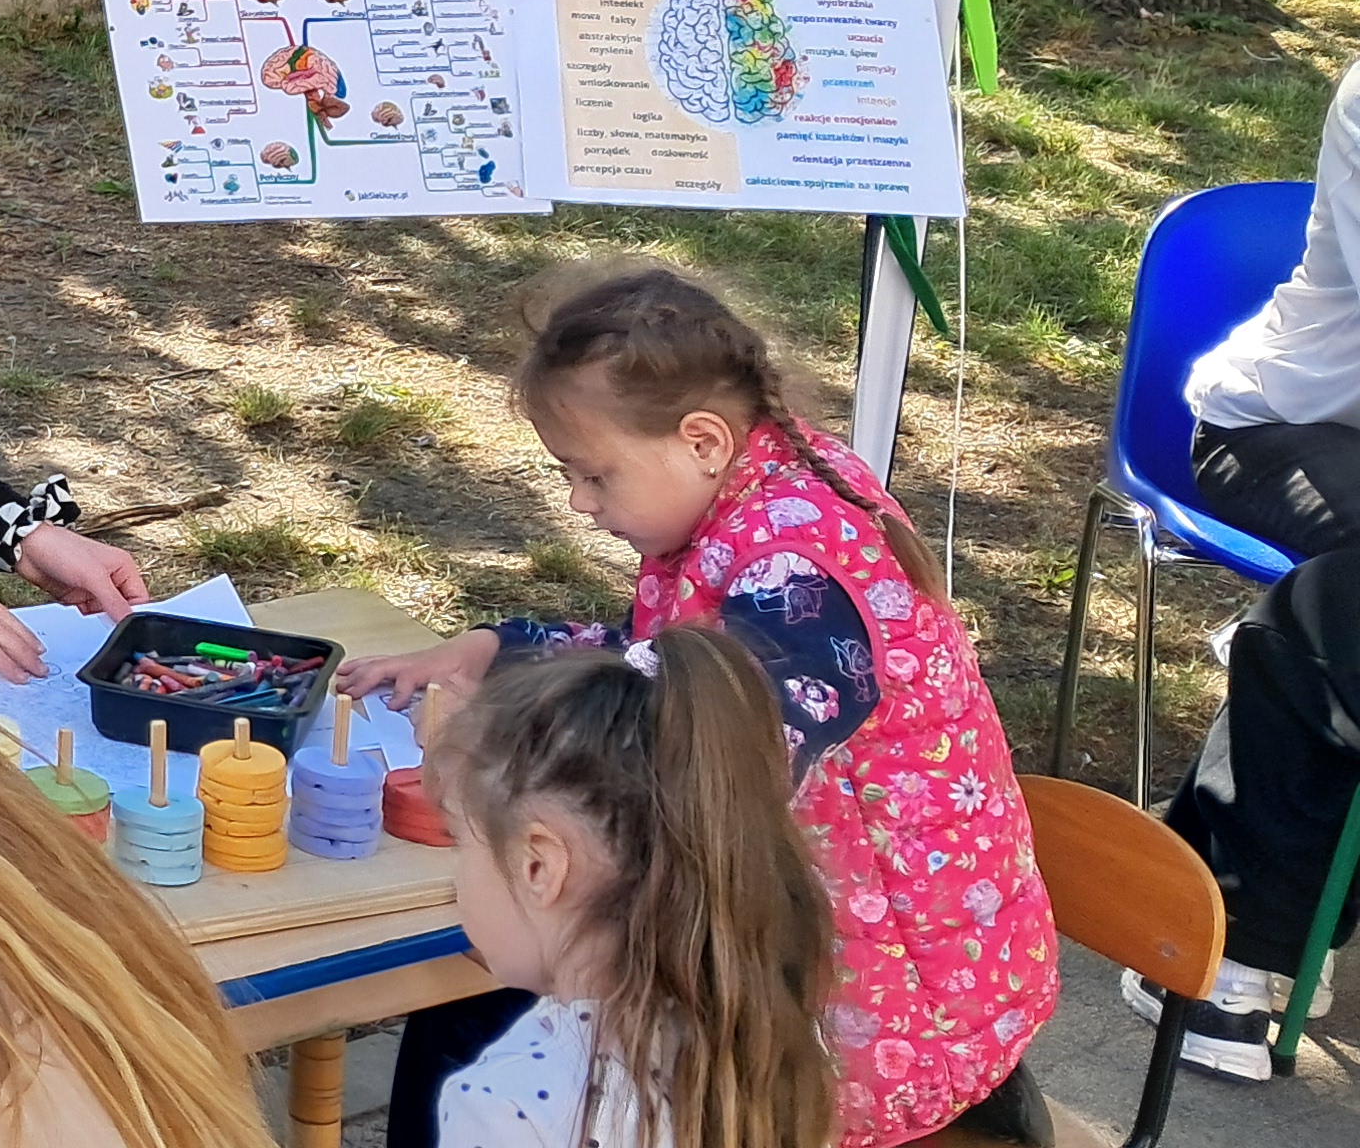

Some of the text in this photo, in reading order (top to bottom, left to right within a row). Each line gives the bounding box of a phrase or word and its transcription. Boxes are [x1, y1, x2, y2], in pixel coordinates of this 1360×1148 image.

[817, 0, 873, 8] wyobraźnia
[571, 12, 601, 20] mowa
[610, 15, 637, 26] fakty
[865, 18, 897, 29] twarzy
[579, 33, 642, 43] abstrakcyjne
[848, 34, 883, 43] uczucia
[566, 62, 612, 73] szczegóły
[856, 65, 897, 75] pomysły
[579, 79, 650, 89] wnioskowanie
[575, 98, 613, 107] liczenie
[633, 112, 663, 122] logika
[794, 114, 898, 126] reakcje emocjonalne
[645, 131, 708, 143] matematyka
[777, 131, 814, 142] pamięć
[873, 136, 909, 147] muzyki
[584, 147, 630, 156] porządek
[651, 148, 709, 159] dosłowność
[793, 154, 911, 168] orientacja przestrzenna
[574, 165, 652, 175] percepcja czasu
[675, 180, 722, 191] szczegóły
